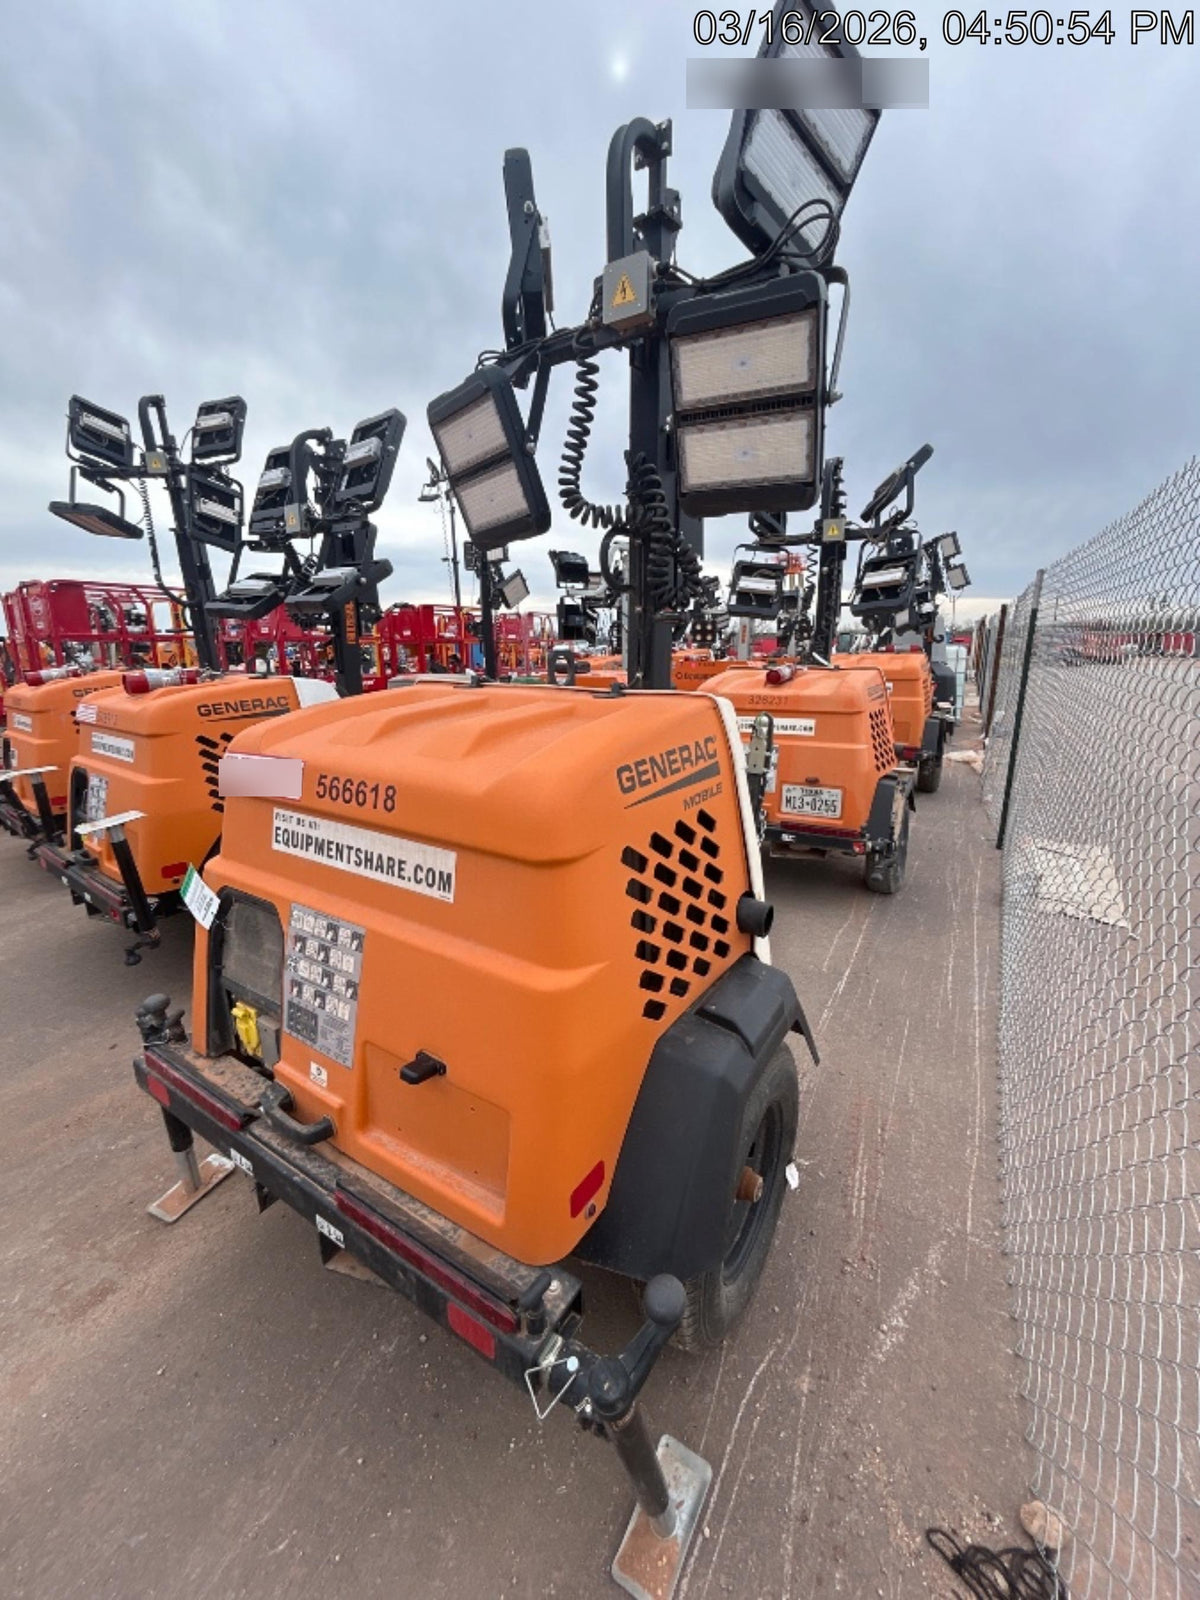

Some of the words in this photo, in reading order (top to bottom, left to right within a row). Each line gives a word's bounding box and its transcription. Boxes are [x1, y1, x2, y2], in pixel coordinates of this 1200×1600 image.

[196, 696, 289, 717] GENERAC
[616, 736, 718, 795] GENERAC
[315, 773, 397, 813] 566618
[682, 782, 723, 812] MOBILE
[274, 826, 453, 894] EQUIPMENTSHARE.COM
